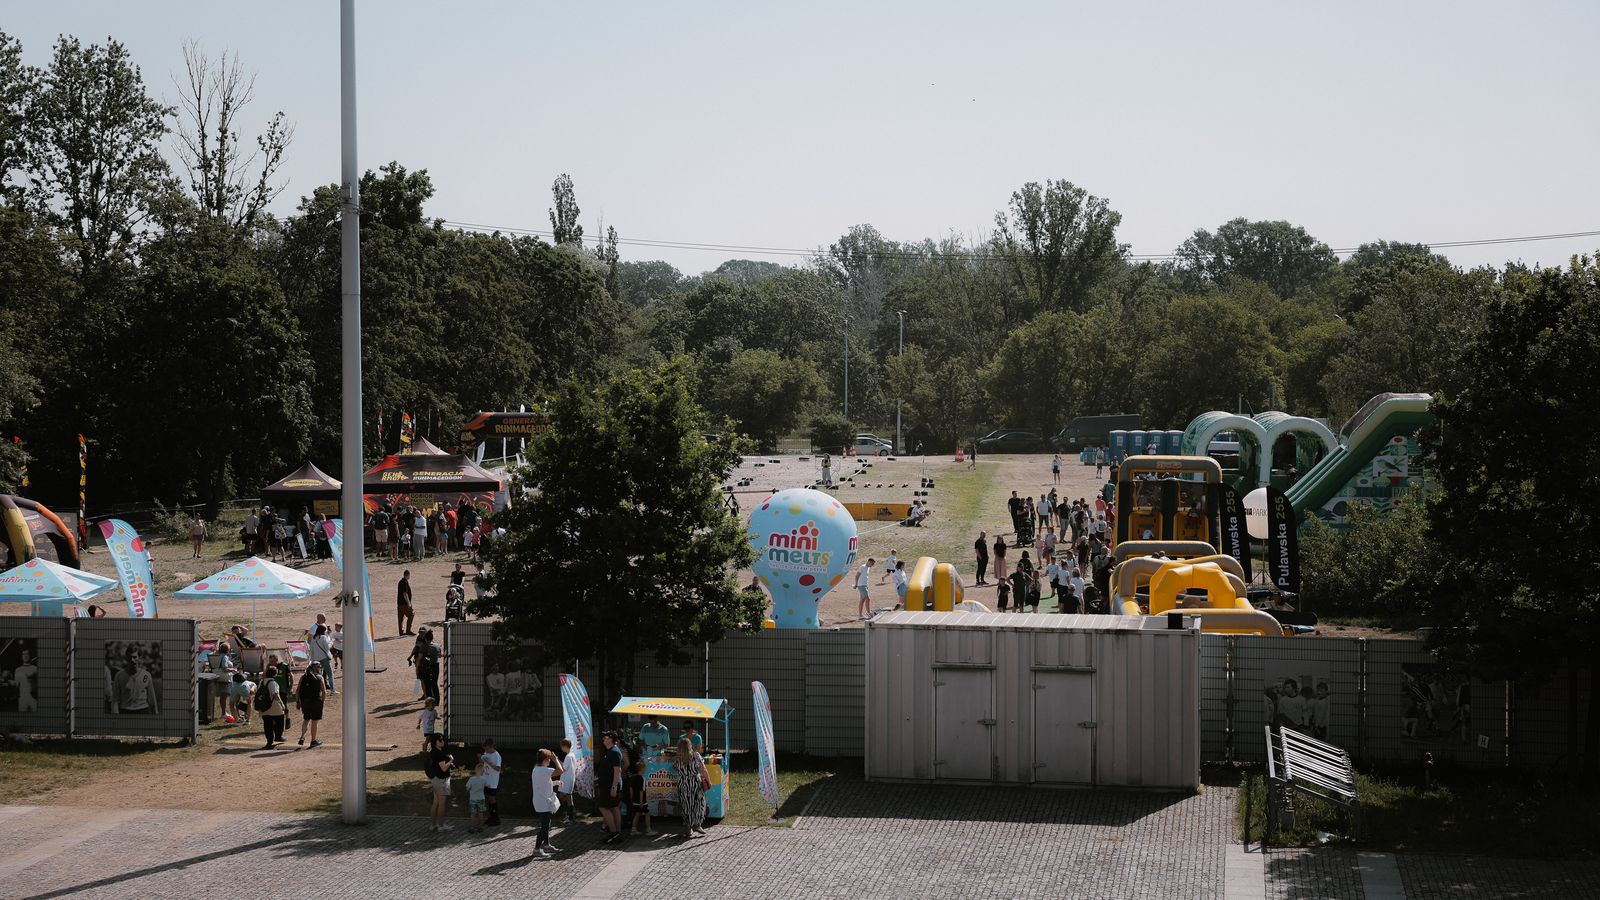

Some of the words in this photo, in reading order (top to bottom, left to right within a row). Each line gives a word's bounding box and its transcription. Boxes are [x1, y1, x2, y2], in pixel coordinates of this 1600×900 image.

[495, 424, 552, 433] RUNMAGEDDO
[1225, 491, 1236, 513] 255
[1274, 496, 1285, 519] 255
[769, 525, 819, 550] mini
[1228, 516, 1241, 562] awska
[1277, 523, 1290, 586] Puławska
